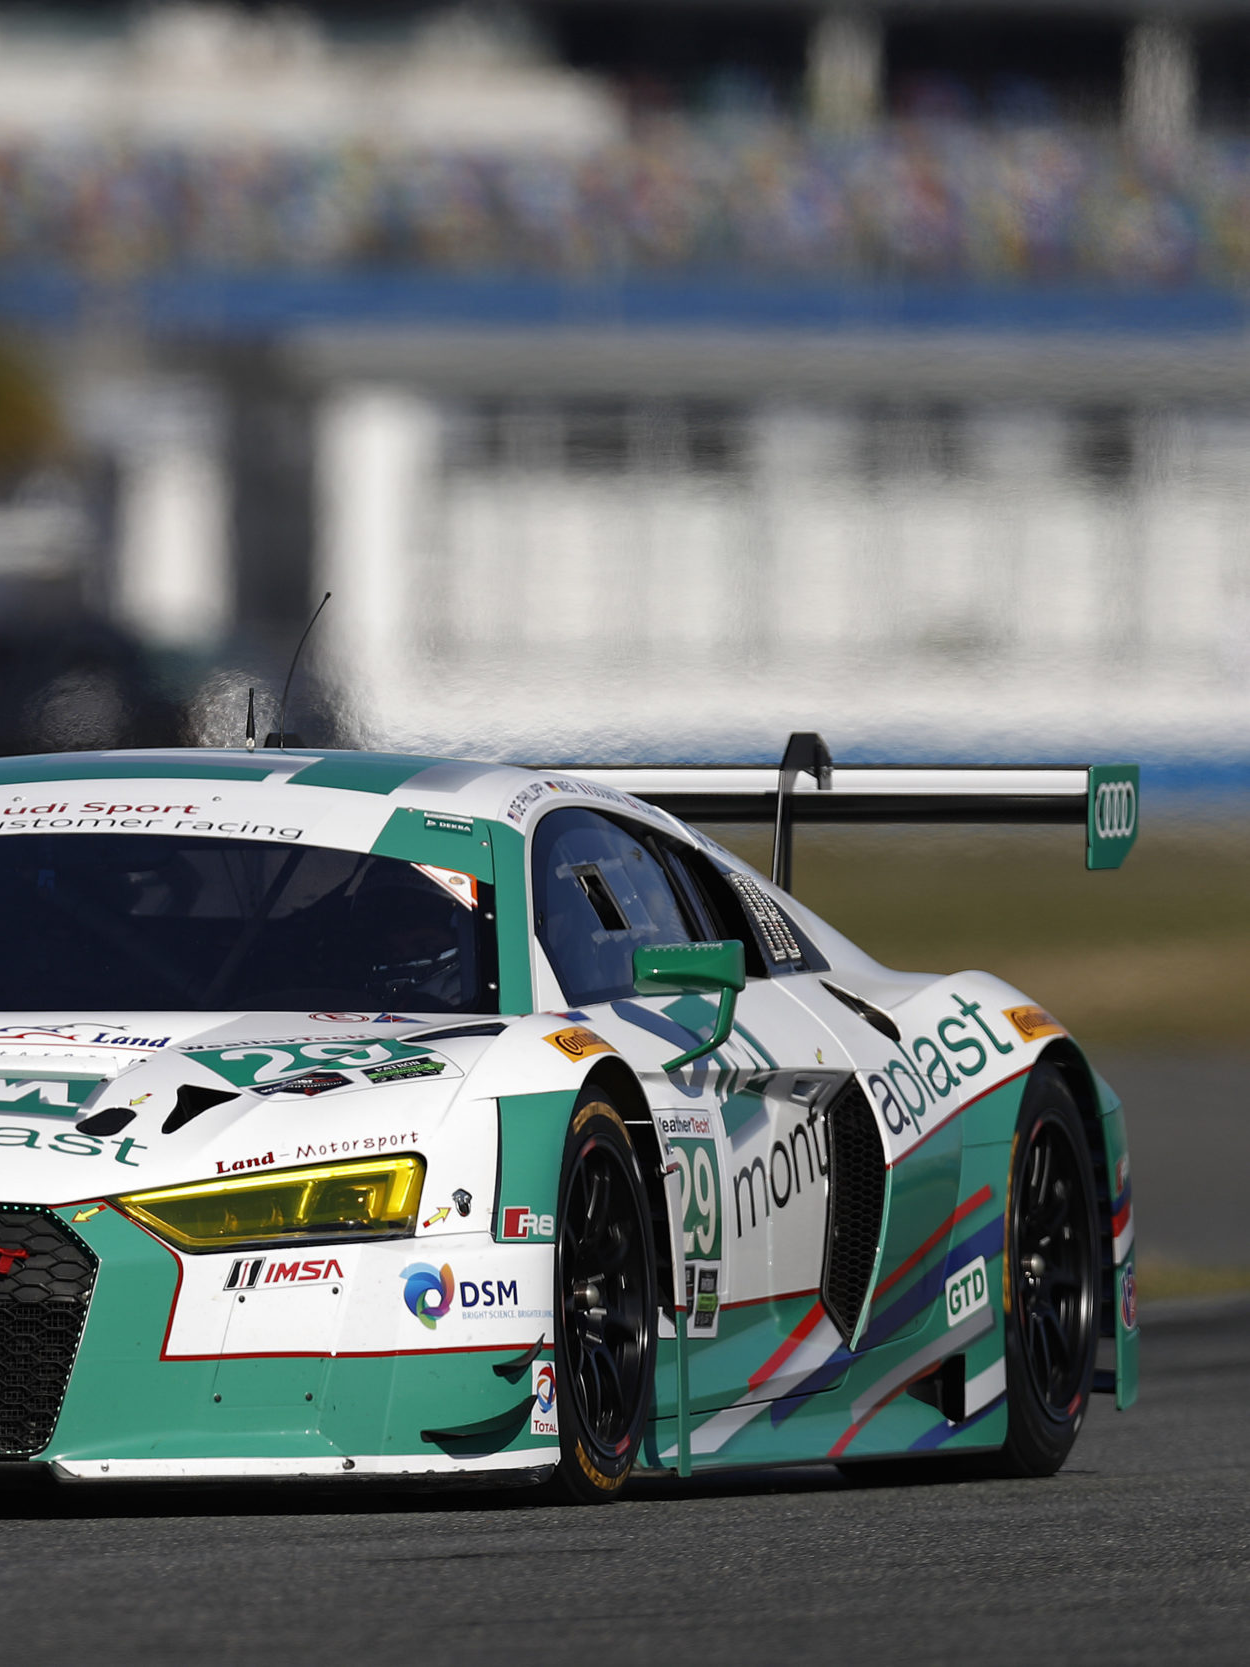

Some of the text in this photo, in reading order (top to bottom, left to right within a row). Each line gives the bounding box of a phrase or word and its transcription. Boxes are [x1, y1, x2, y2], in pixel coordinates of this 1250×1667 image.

[79, 801, 201, 818] Sport
[174, 819, 304, 841] racing
[439, 821, 472, 832] DEKRA
[92, 1032, 172, 1048] Land
[220, 1043, 393, 1084] 29
[658, 1117, 710, 1134] eatherTech
[215, 1151, 275, 1175] Land
[296, 1131, 419, 1160] Motorsport
[517, 1213, 554, 1237] R8
[264, 1258, 344, 1284] IMSA
[459, 1280, 518, 1308] DSM
[949, 1267, 984, 1315] GTD
[462, 1311, 487, 1320] BRIGHT
[533, 1420, 558, 1433] TOTAL
